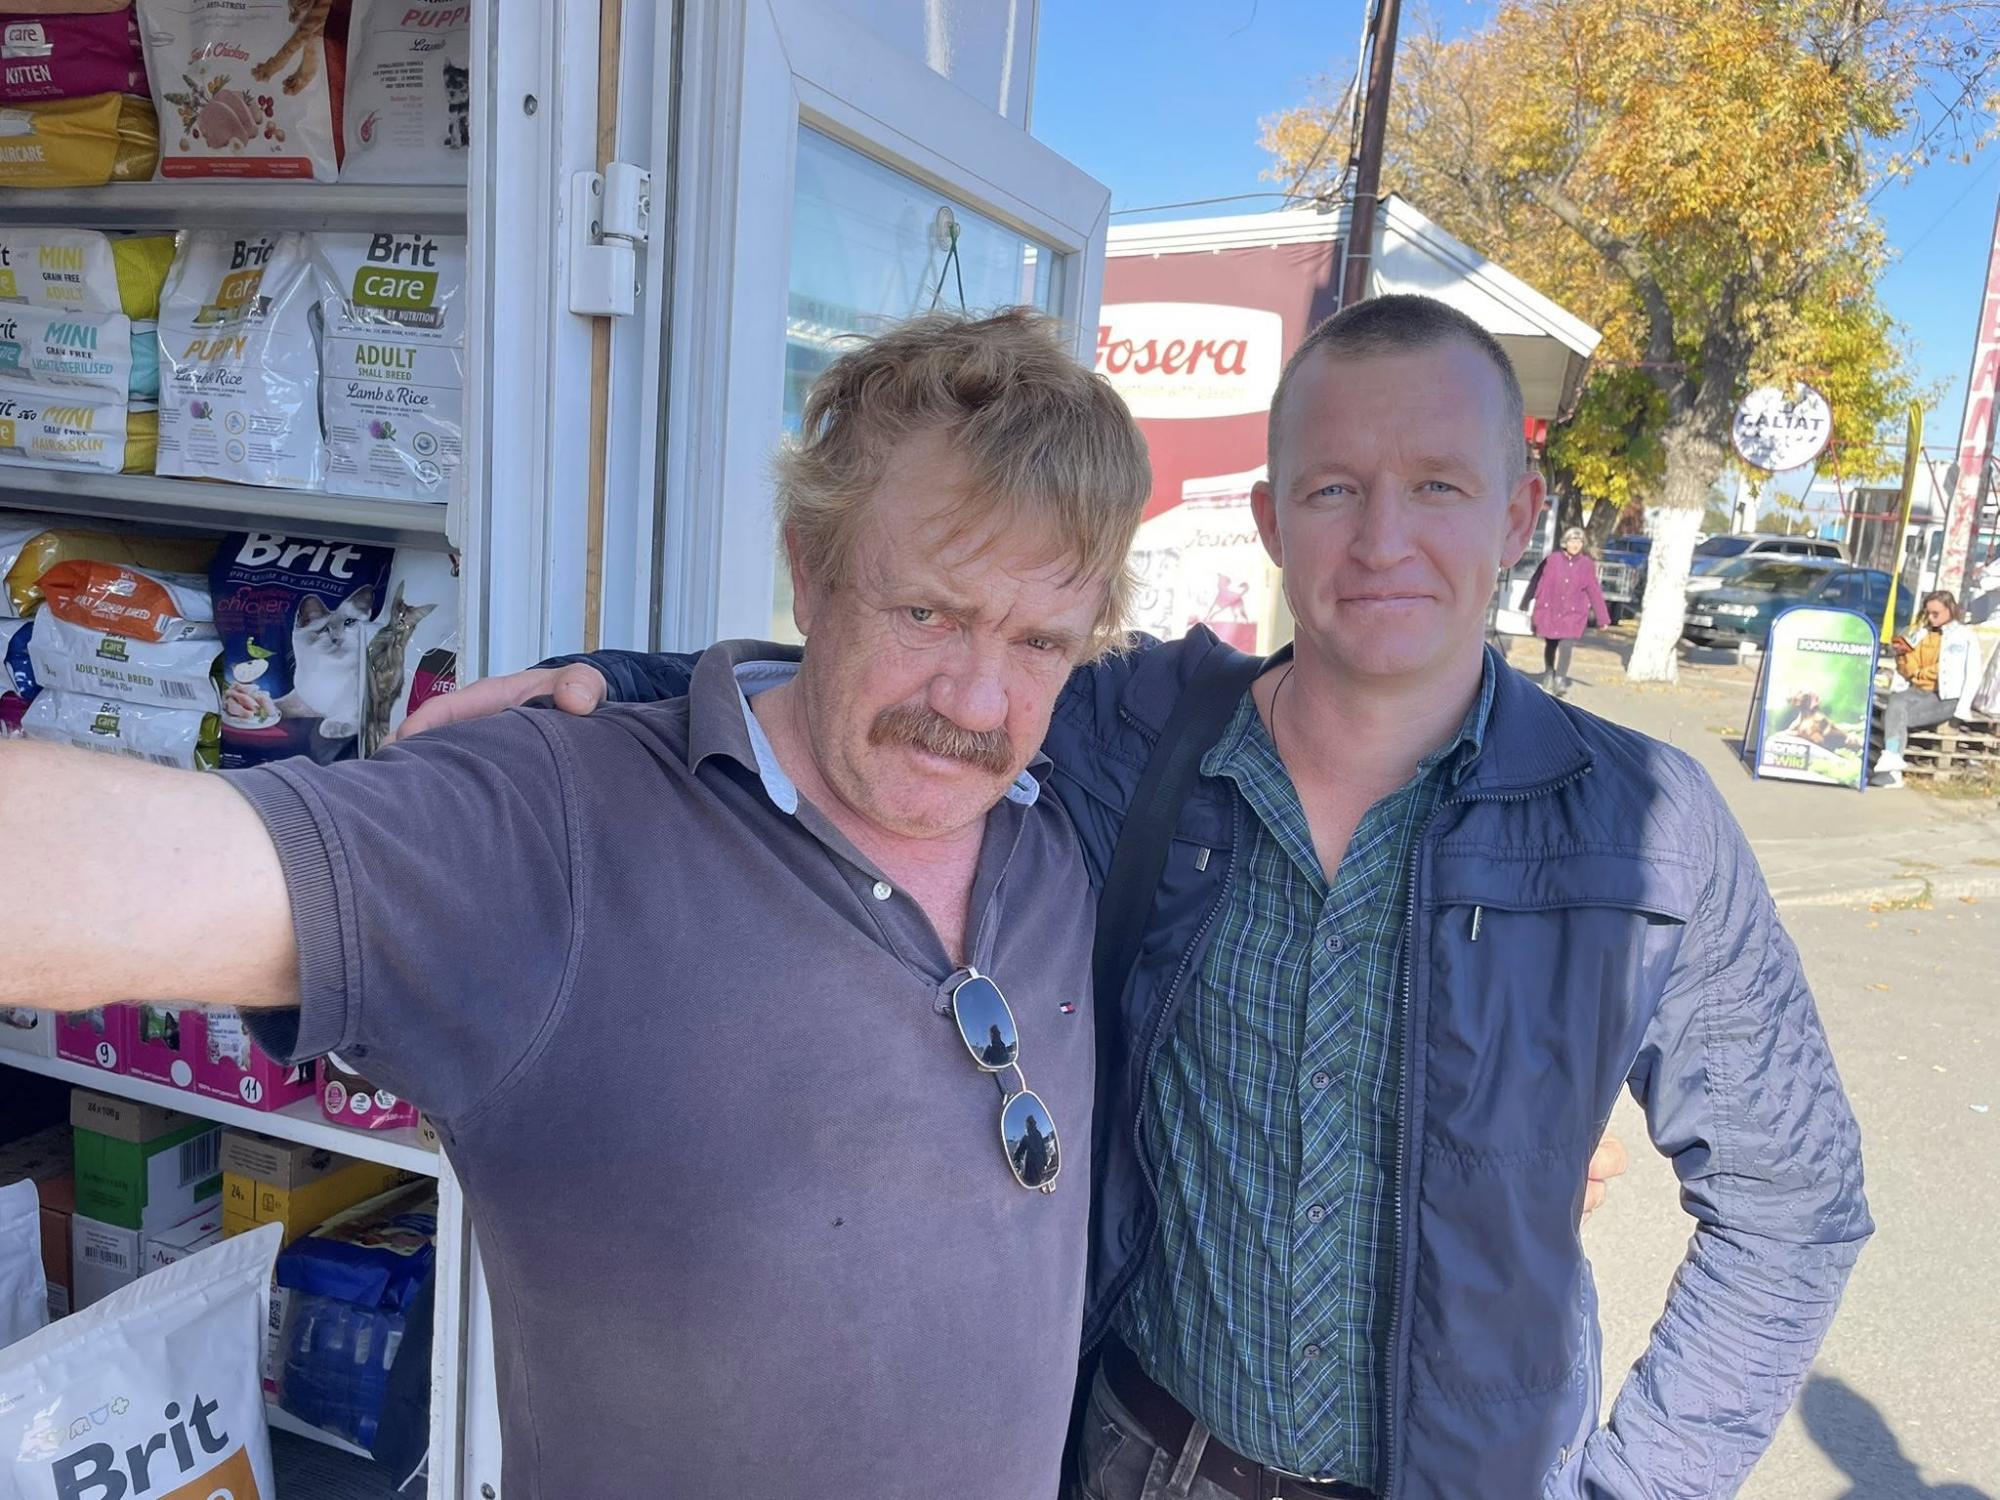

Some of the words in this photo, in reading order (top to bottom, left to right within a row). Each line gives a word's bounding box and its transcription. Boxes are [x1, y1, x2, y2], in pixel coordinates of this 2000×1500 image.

[9, 28, 38, 41] care
[6, 64, 52, 83] KITTEN
[0, 145, 45, 162] AIRCARE
[39, 244, 84, 271] MINI
[367, 232, 439, 267] Brit
[42, 272, 62, 282] GRAIN
[64, 273, 80, 283] FREE
[364, 276, 425, 300] care
[400, 310, 436, 325] NUTRITION
[0, 318, 17, 339] rit
[44, 322, 97, 350] MINI
[69, 349, 93, 359] FREE
[182, 336, 248, 362] PUPPY
[355, 344, 417, 369] ADULT
[215, 368, 242, 386] Rice
[358, 367, 383, 379] SMALL
[386, 371, 412, 381] BREED
[346, 382, 383, 400] Lamb
[385, 388, 395, 402] &
[397, 387, 429, 406] Rice
[42, 406, 94, 431] MINI
[235, 532, 361, 579] Brit
[229, 570, 277, 582] PREMIUM
[281, 575, 296, 584] BY
[300, 579, 344, 594] NATURE
[103, 642, 123, 654] care
[1800, 641, 1873, 656] ЗООМАГАЗИН
[75, 664, 98, 676] ADULT
[101, 668, 124, 681] SMALL
[127, 674, 153, 686] BREED
[432, 681, 456, 693] STER
[101, 702, 120, 715] Brit
[98, 718, 116, 729] care
[100, 1044, 109, 1063] 9
[244, 1079, 257, 1099] 11
[52, 1393, 229, 1500] Brit
